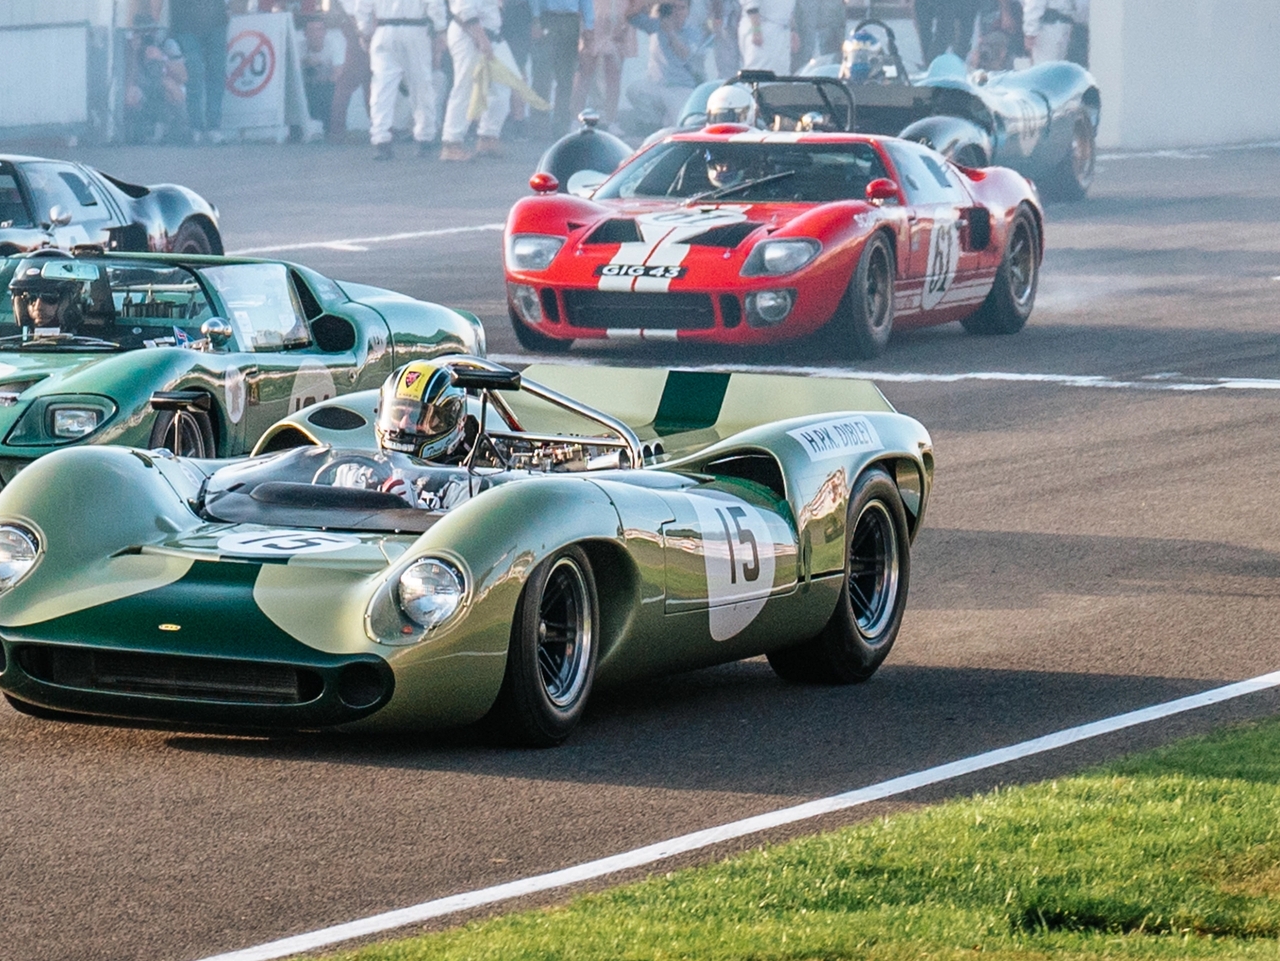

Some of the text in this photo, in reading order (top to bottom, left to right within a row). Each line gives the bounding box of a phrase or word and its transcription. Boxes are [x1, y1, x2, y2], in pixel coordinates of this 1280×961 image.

[228, 50, 267, 77] 20
[602, 265, 681, 278] GIG 43
[928, 224, 952, 294] 61
[832, 420, 874, 448] DIBLEY
[237, 533, 345, 551] 15
[714, 506, 760, 585] 15
